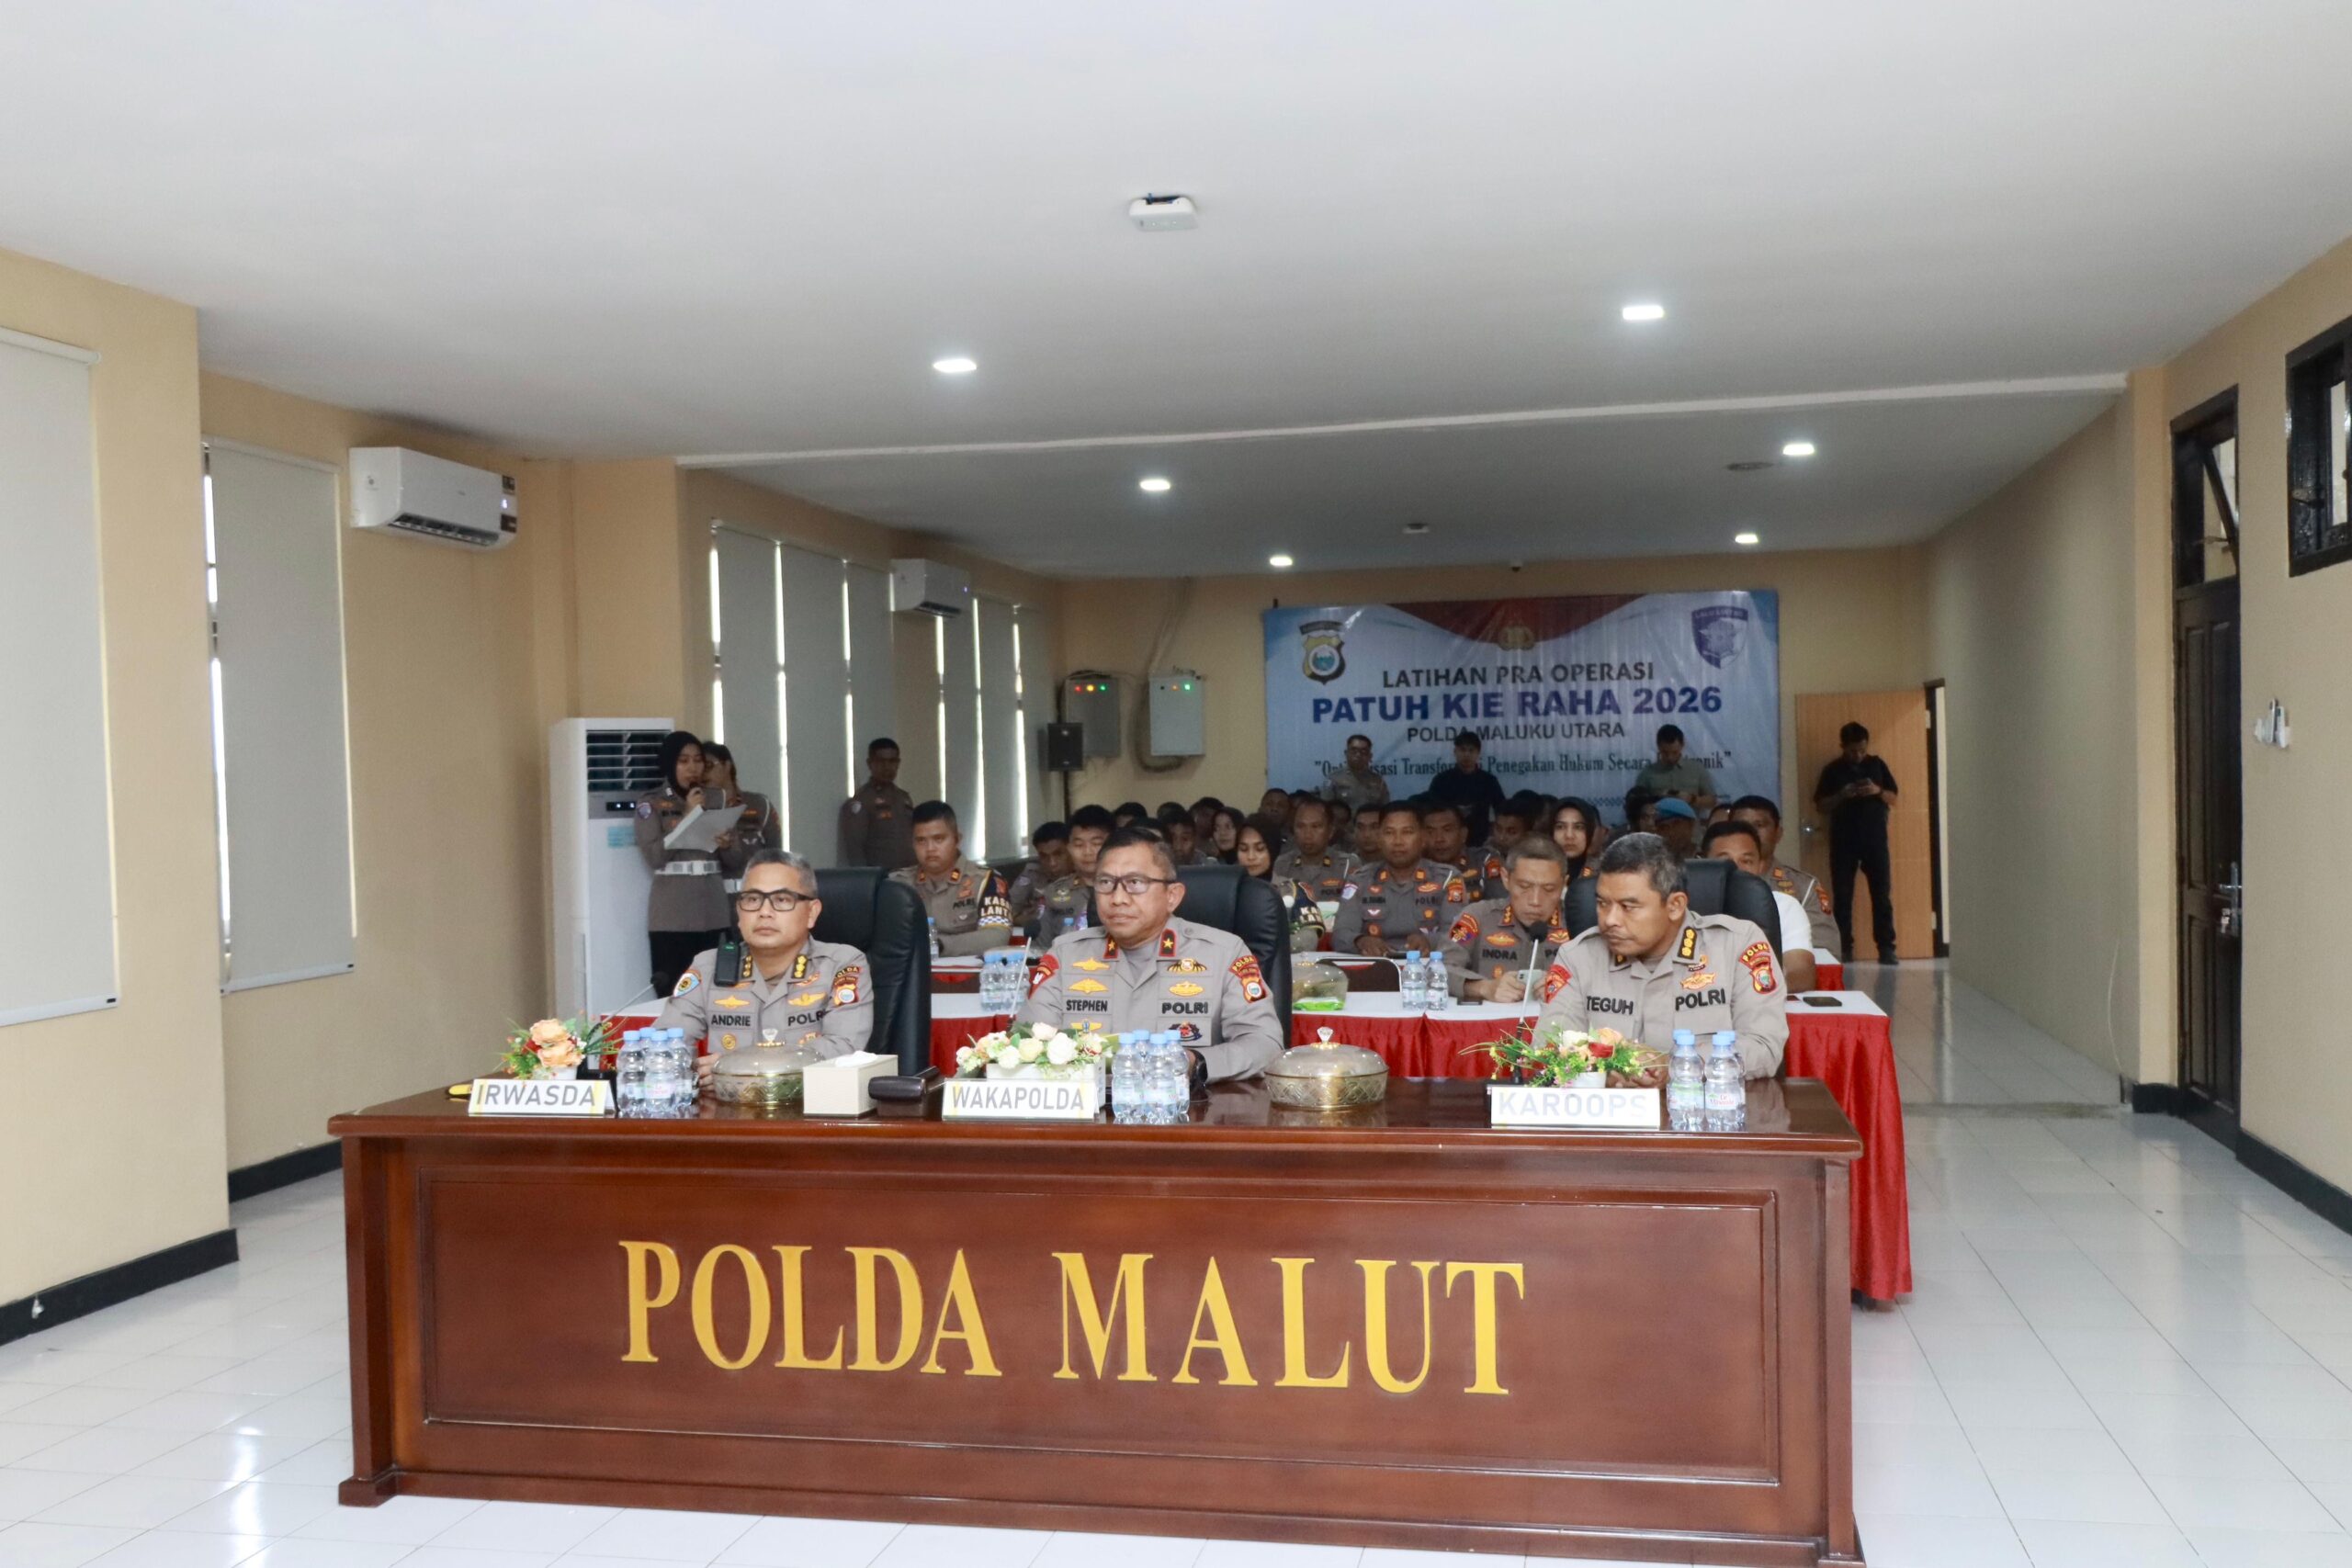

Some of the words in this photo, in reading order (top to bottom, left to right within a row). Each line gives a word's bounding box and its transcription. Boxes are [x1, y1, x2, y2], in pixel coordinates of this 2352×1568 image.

[1383, 667, 1487, 688] LATIHAN
[1497, 665, 1543, 684] PRA
[1551, 661, 1654, 682] OPERASI
[1313, 695, 1429, 723] PATUH
[1443, 692, 1504, 719] KIE
[1518, 689, 1622, 716] RAHA
[1633, 686, 1723, 714] 2026
[1476, 724, 1555, 740] MALUKU
[1561, 722, 1625, 739] UTARA
[1487, 755, 1555, 775] Penegakan
[1560, 754, 1604, 772] Hukum
[1609, 753, 1652, 772] Secara
[1482, 948, 1517, 960] INDRA
[1743, 942, 1769, 962] POLDA
[1231, 956, 1255, 972] POLDA
[1066, 998, 1108, 1012] STEPHEN
[1161, 1002, 1209, 1014] POLRI
[1587, 996, 1634, 1015] TEGUH
[1675, 988, 1726, 1011] POLRI
[711, 1013, 752, 1027] ANDRIE
[476, 1084, 596, 1107] IRWASDA
[951, 1086, 1084, 1111] WAKAPOLDA
[1498, 1091, 1648, 1118] KAROOPS
[618, 1240, 1002, 1377] POLDA
[1052, 1252, 1524, 1394] MALUT
